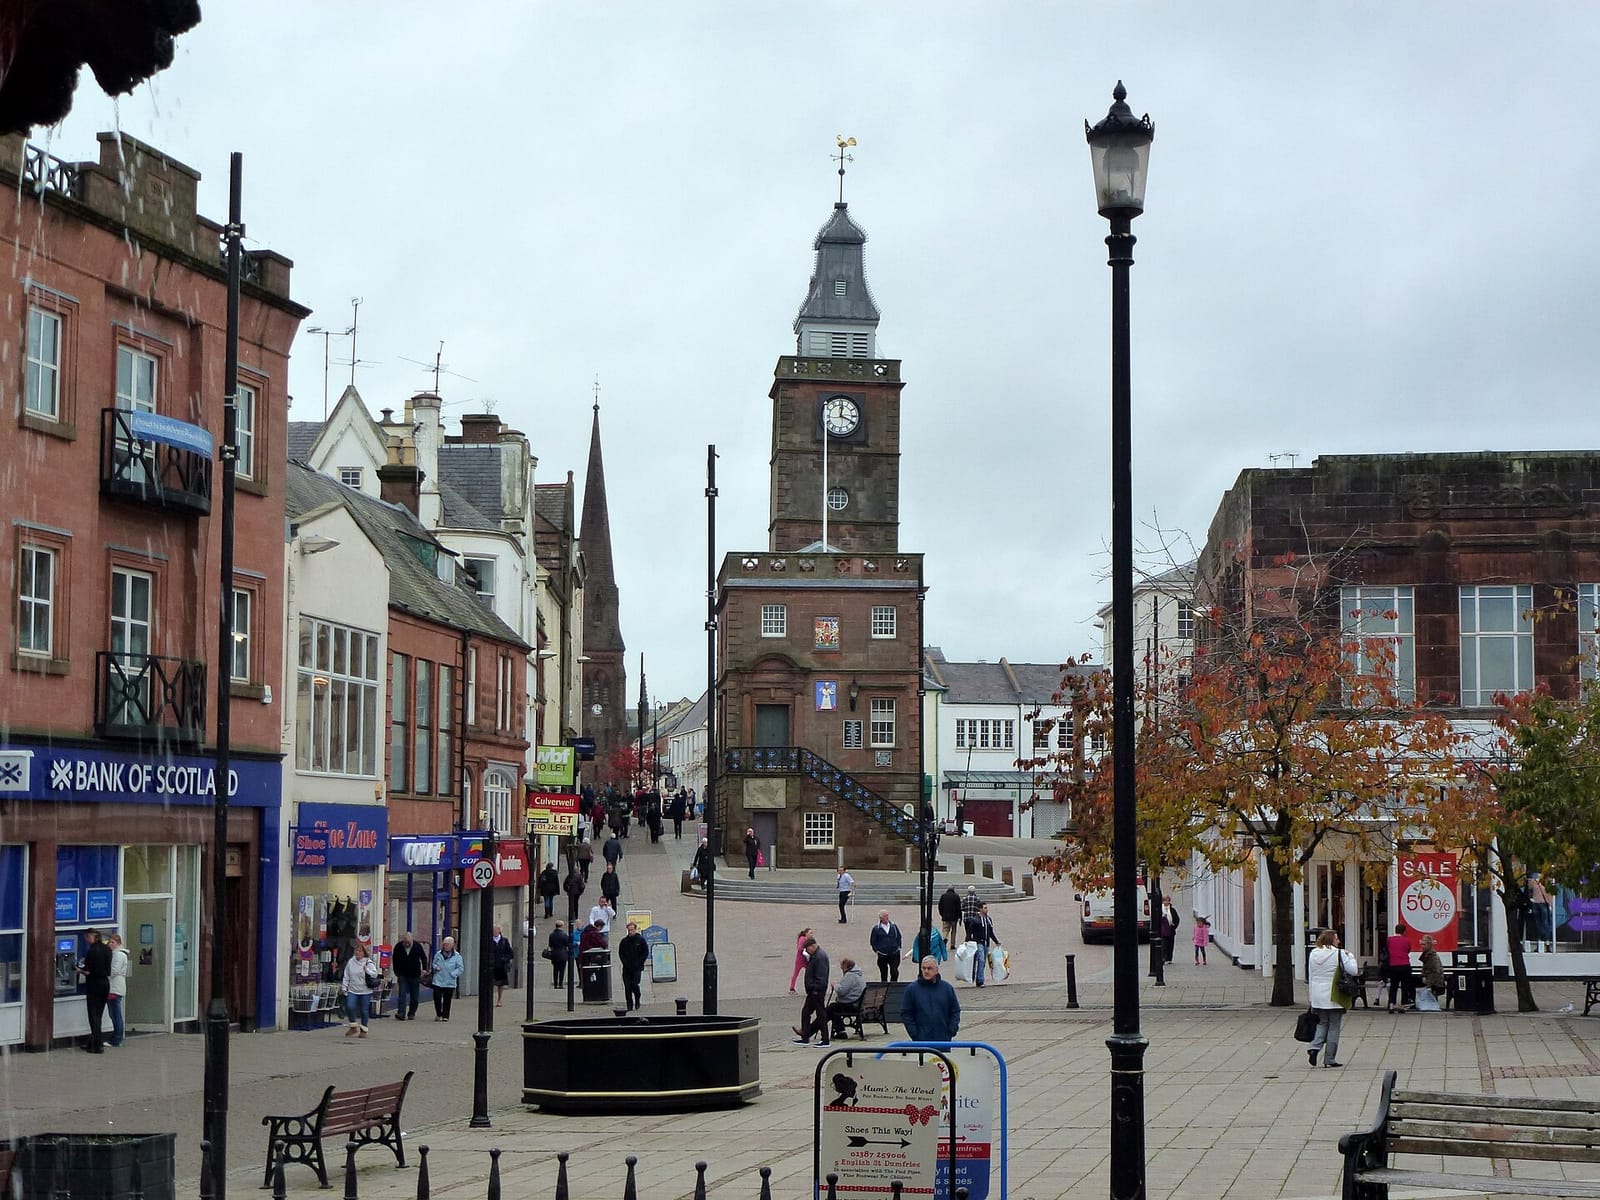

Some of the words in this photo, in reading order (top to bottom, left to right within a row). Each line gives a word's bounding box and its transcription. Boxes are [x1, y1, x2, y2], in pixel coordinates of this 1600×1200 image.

[537, 764, 546, 772] O
[550, 764, 567, 772] LET
[76, 760, 124, 792] BANK
[128, 763, 152, 793] OF
[156, 765, 239, 797] SCOTLAD
[534, 796, 575, 807] Culverwell
[553, 815, 573, 824] LET
[314, 820, 345, 849] oe
[346, 821, 377, 849] Zone
[296, 835, 326, 850] Shoe
[296, 850, 325, 865] Zone
[475, 867, 492, 880] 20
[1402, 861, 1453, 877] SALE
[1406, 894, 1451, 912] 50%
[1433, 912, 1451, 920] OFF
[860, 1084, 889, 1093] Mum's
[892, 1085, 907, 1094] The
[909, 1086, 935, 1095] Word
[956, 1095, 980, 1109] ite
[844, 1125, 870, 1135] Shoes
[871, 1126, 891, 1136] This
[894, 1127, 913, 1137] Way!
[850, 1150, 874, 1158] 01387
[876, 1151, 907, 1159] 259006
[841, 1159, 871, 1168] English
[884, 1160, 921, 1168] Dumfries
[943, 1166, 968, 1175] fied
